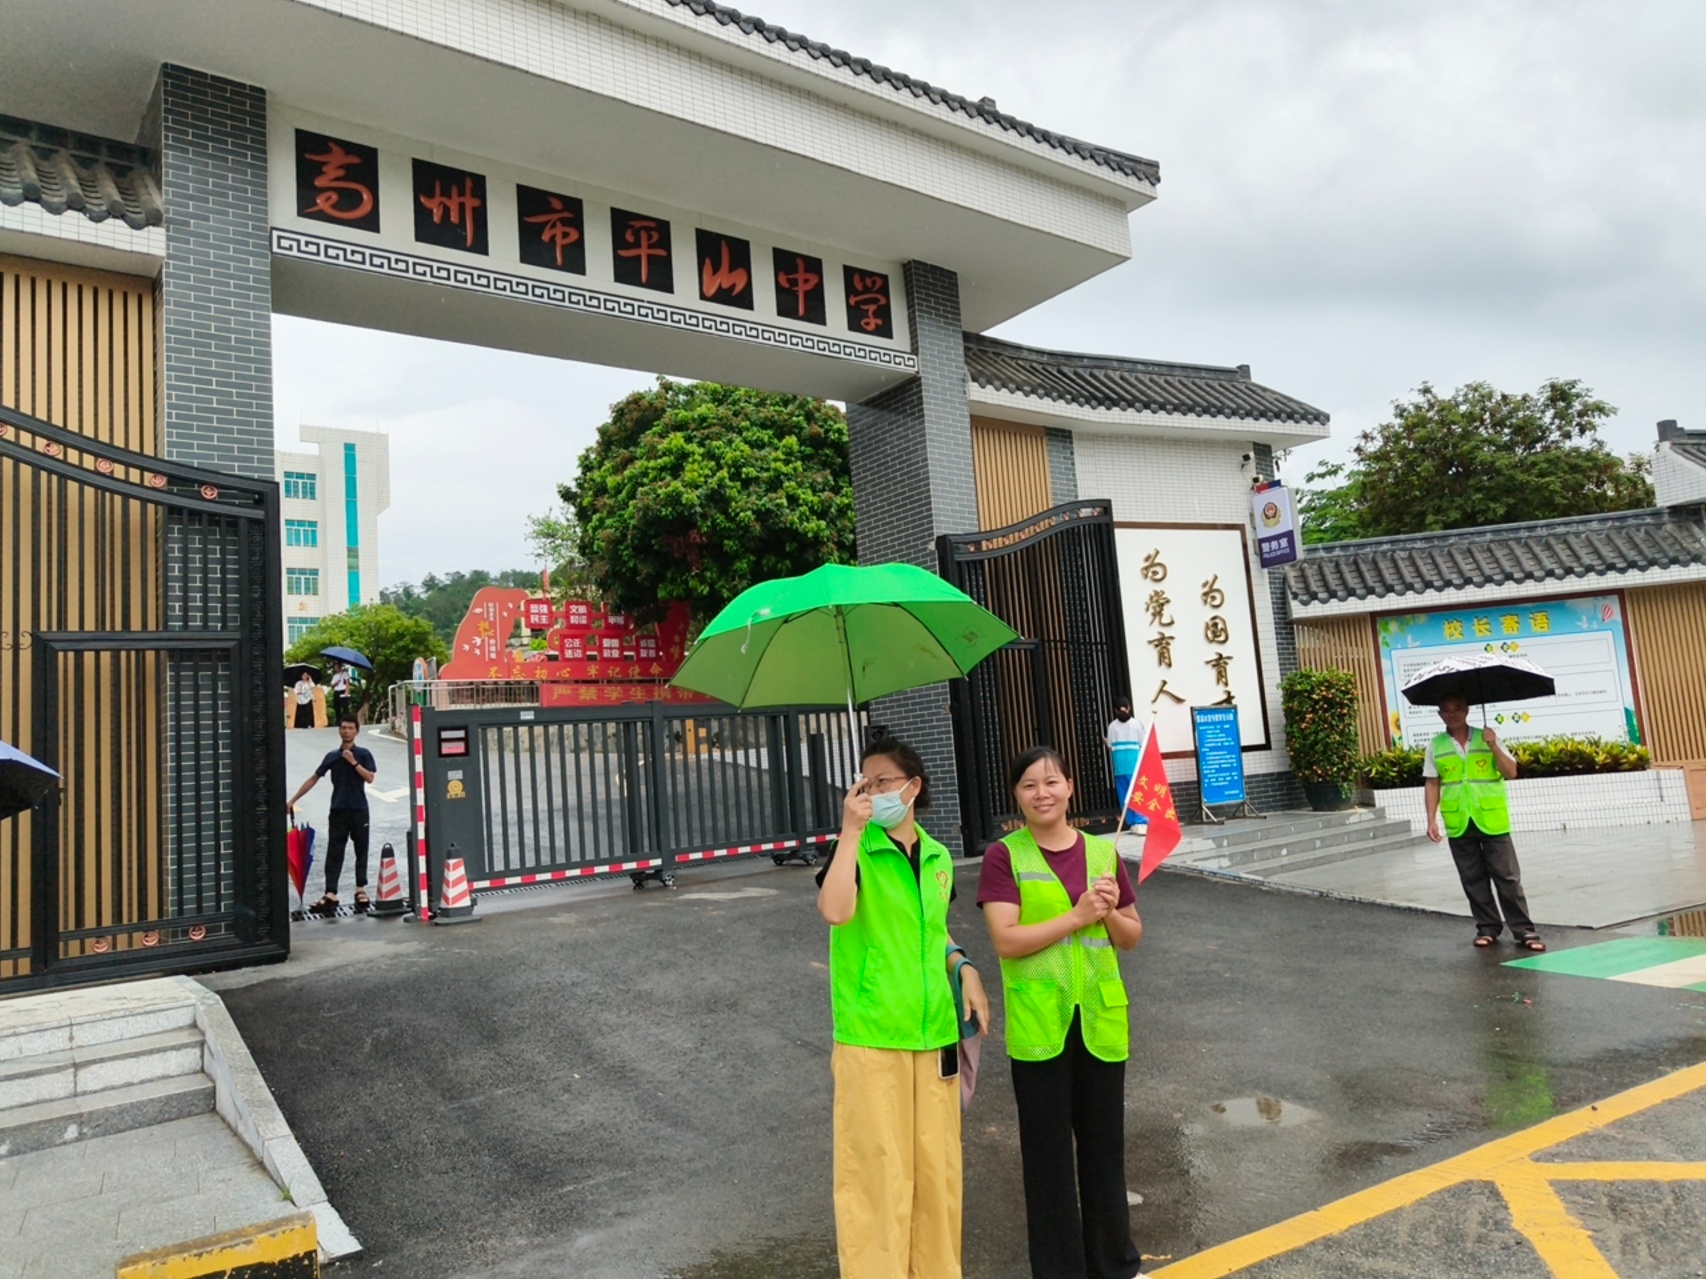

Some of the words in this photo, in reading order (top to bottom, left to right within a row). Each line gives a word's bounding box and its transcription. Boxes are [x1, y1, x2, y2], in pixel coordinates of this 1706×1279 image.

[303, 142, 888, 331] 高州市平山中学
[570, 605, 587, 614] 文明
[530, 614, 548, 624] 民主
[1139, 548, 1186, 705] 为党育人
[1443, 610, 1551, 640] 校长寄语
[564, 638, 582, 648] 公正
[487, 664, 571, 680] 不忘初心
[587, 662, 663, 679] 牢记使命
[552, 685, 709, 700] 严禁学生携带
[1137, 774, 1169, 798] 文明
